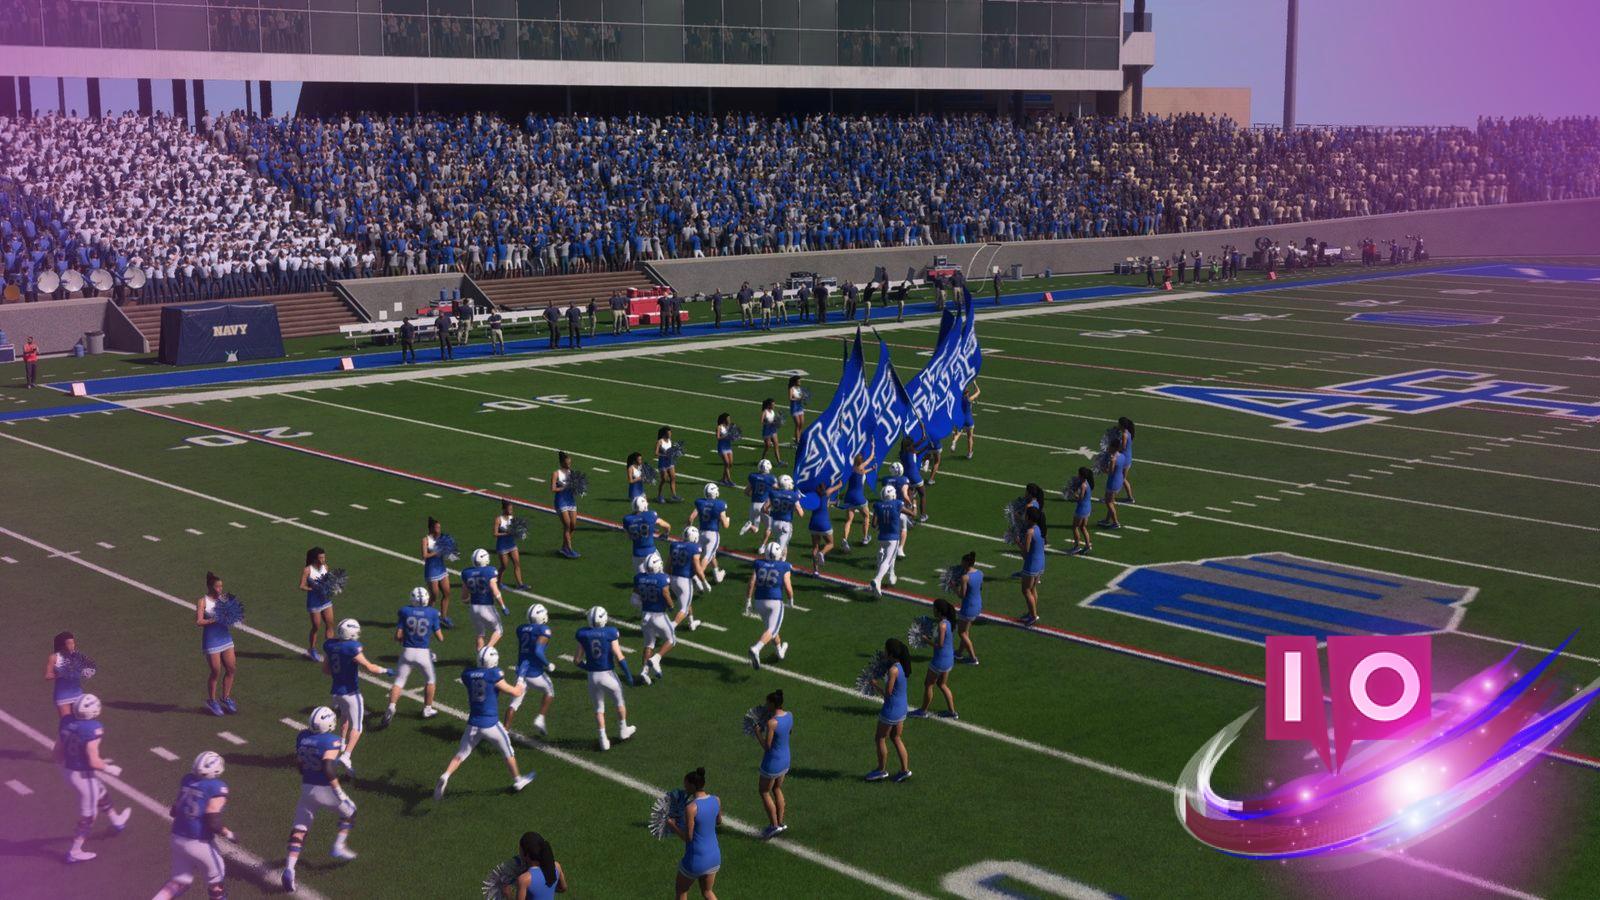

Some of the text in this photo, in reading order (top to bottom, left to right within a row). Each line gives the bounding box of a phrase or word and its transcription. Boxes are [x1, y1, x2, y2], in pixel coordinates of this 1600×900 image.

[212, 324, 248, 337] NAVY
[481, 394, 595, 411] 30
[184, 426, 312, 447] 20
[406, 616, 430, 637] 96
[520, 632, 530, 653] 2
[590, 639, 602, 659] 6
